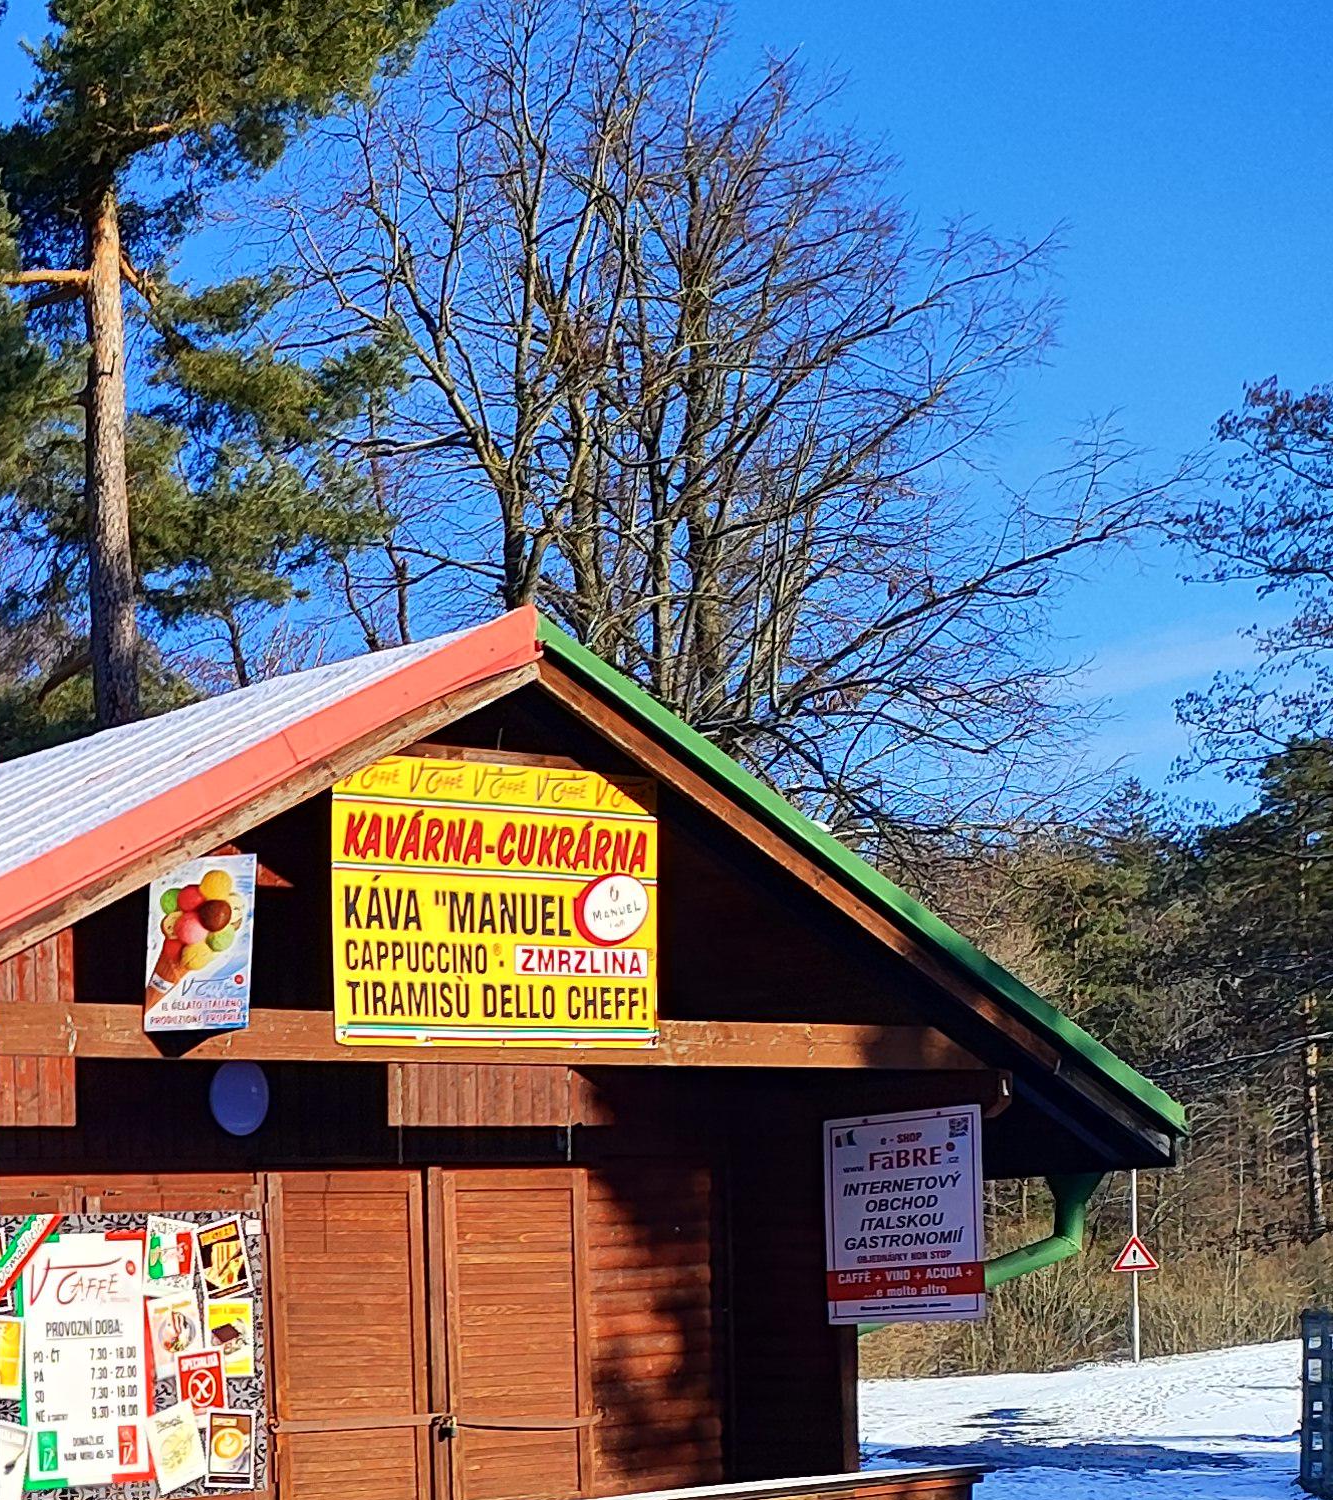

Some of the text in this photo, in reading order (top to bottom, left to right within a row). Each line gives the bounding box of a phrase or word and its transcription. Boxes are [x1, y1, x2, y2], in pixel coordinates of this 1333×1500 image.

[343, 810, 647, 873] KAVÁRNA-CUKRÁRNA
[344, 875, 422, 931] KÁVA
[345, 939, 642, 976] CAPPUCCINO ZMRZLINA
[172, 1000, 202, 1011] GELATO
[347, 976, 648, 1020] TIRAMISÙ DELLO CHEFF!
[897, 1132, 923, 1144] SHOP
[843, 1171, 962, 1197] INTERNETOVÝ
[865, 1194, 938, 1213] OBCHOD
[860, 1212, 944, 1232] ITALSKOU
[844, 1226, 965, 1250] GASTRONOMIÍ
[930, 1250, 951, 1259] STOP
[885, 1270, 911, 1282] VINO
[925, 1266, 962, 1280] ACQUA
[887, 1285, 917, 1297] molto
[921, 1284, 947, 1296] altro
[46, 1317, 93, 1337] PROVOZNÍ
[33, 1351, 43, 1363] PO
[90, 1347, 108, 1360] 7.30
[90, 1367, 108, 1380] 7.30
[115, 1365, 137, 1379] 22.00
[35, 1390, 45, 1403] SO
[91, 1387, 108, 1400] 7.30
[117, 1385, 137, 1398] 18.00
[92, 1406, 109, 1419] 9.30
[117, 1404, 138, 1417] 18.00
